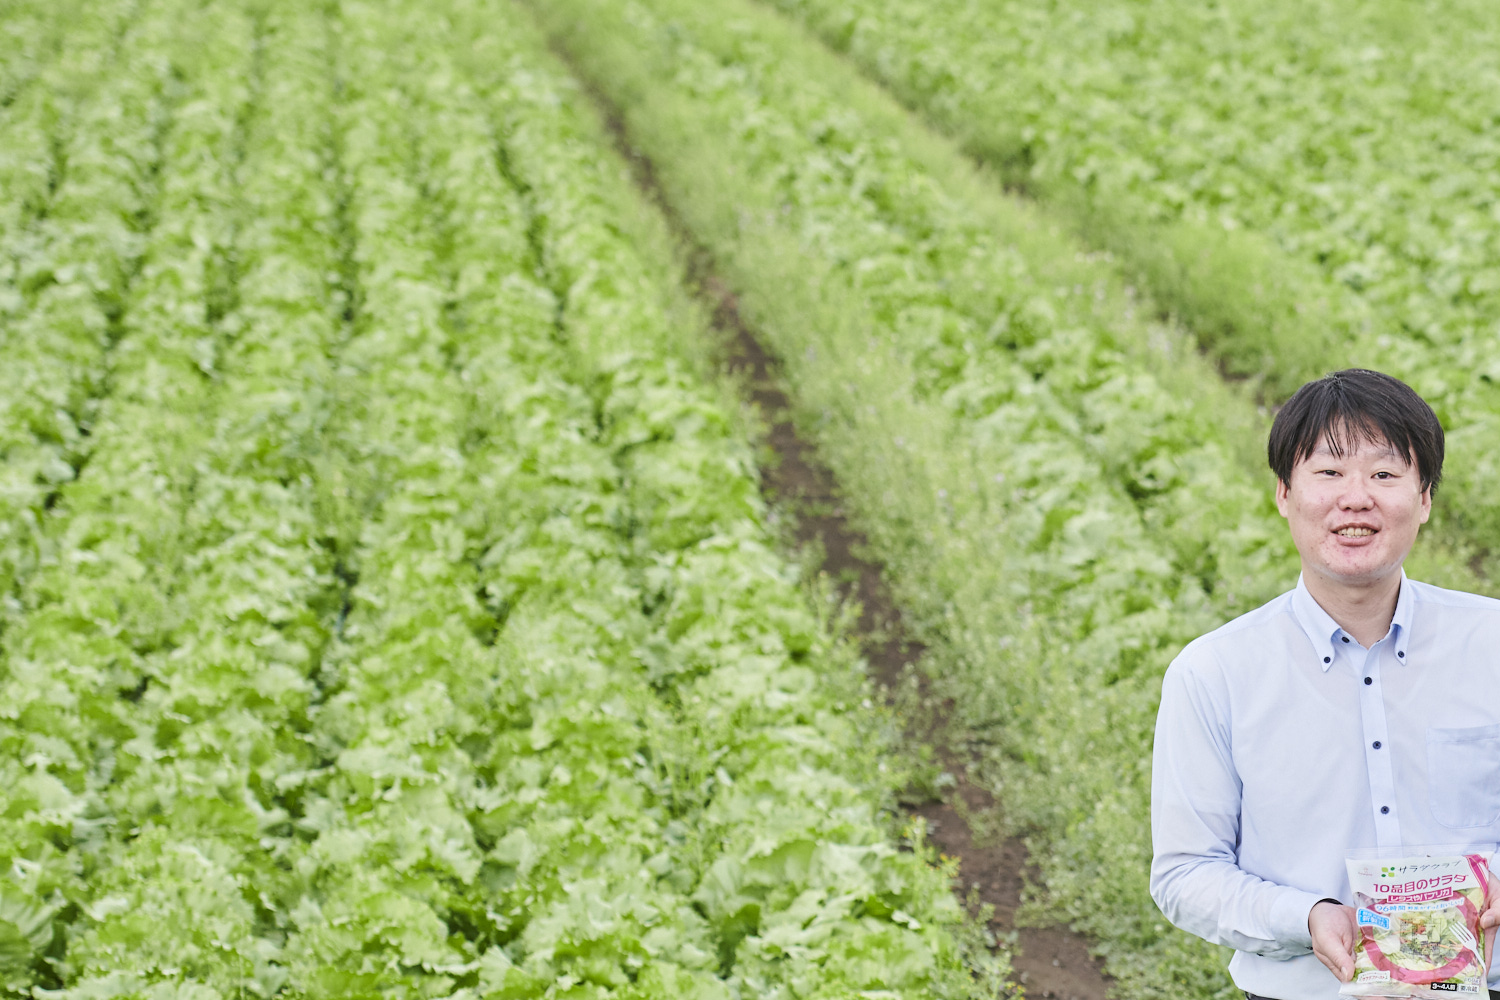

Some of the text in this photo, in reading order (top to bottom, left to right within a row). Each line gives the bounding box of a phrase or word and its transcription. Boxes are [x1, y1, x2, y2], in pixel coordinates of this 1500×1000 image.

[1373, 874, 1469, 893] 10品目のサラダ
